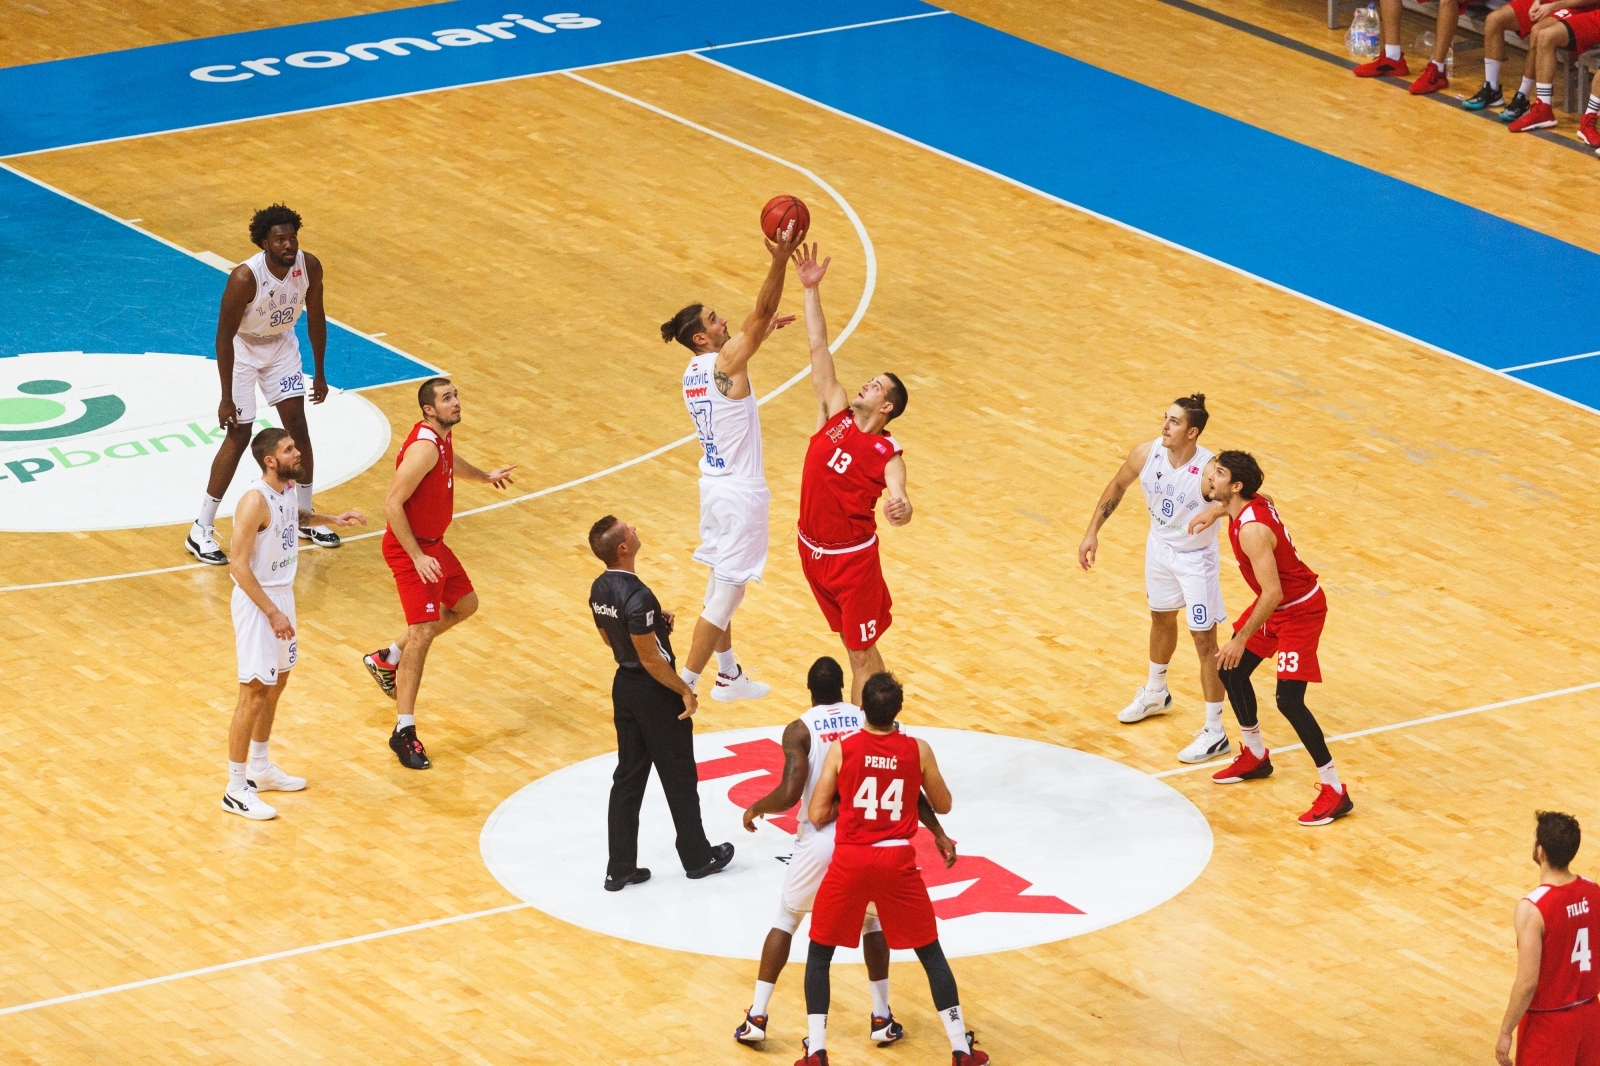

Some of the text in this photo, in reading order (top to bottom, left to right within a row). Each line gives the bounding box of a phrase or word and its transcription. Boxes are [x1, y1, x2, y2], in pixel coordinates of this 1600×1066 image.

[190, 13, 601, 82] cromaris
[270, 307, 294, 327] 32
[280, 372, 303, 393] 32
[827, 447, 852, 474] 13
[1162, 498, 1175, 518] 9
[1192, 604, 1207, 624] 9
[859, 619, 877, 642] 13
[1277, 651, 1299, 673] 33
[814, 716, 859, 731] CARTER
[864, 755, 898, 770] PERIĆ
[853, 776, 905, 821] 44
[1566, 896, 1590, 918] FILIĆ
[1570, 927, 1592, 972] 4
